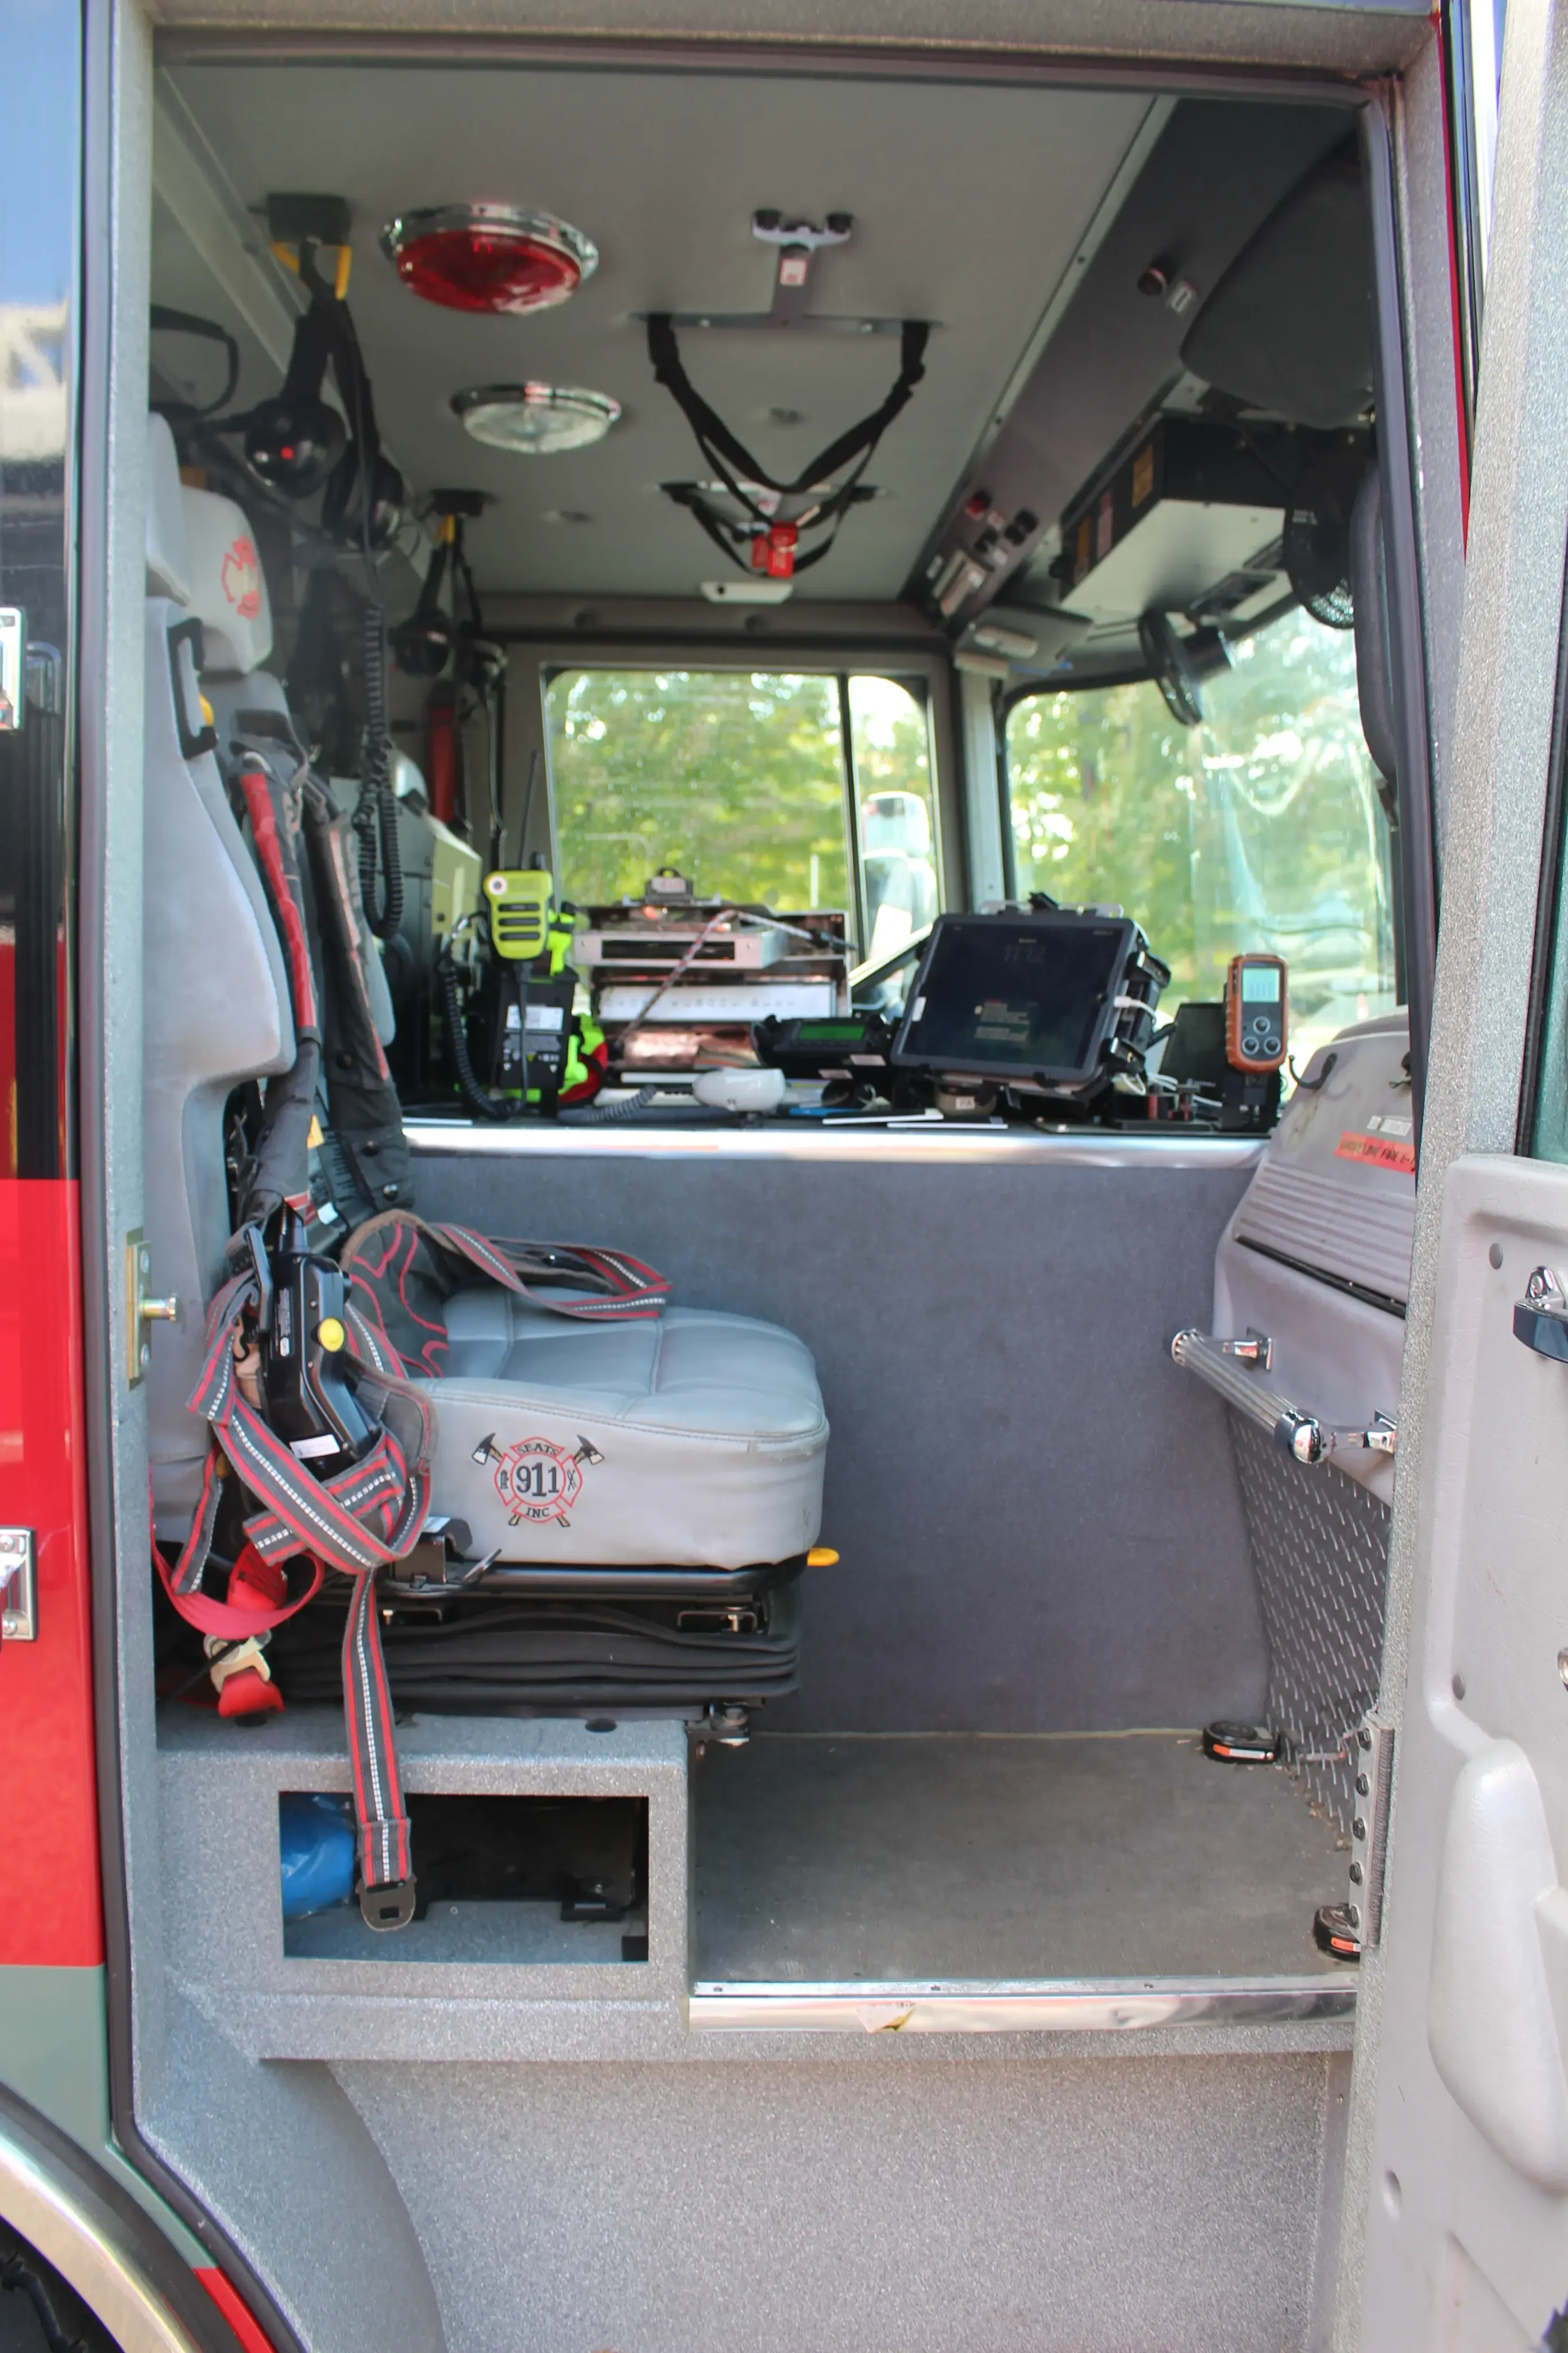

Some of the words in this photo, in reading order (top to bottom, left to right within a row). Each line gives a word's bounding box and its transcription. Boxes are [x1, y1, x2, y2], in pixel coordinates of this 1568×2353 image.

[517, 1443, 558, 1456] SEATS
[516, 1462, 559, 1497] 911
[526, 1507, 550, 1518] INC
